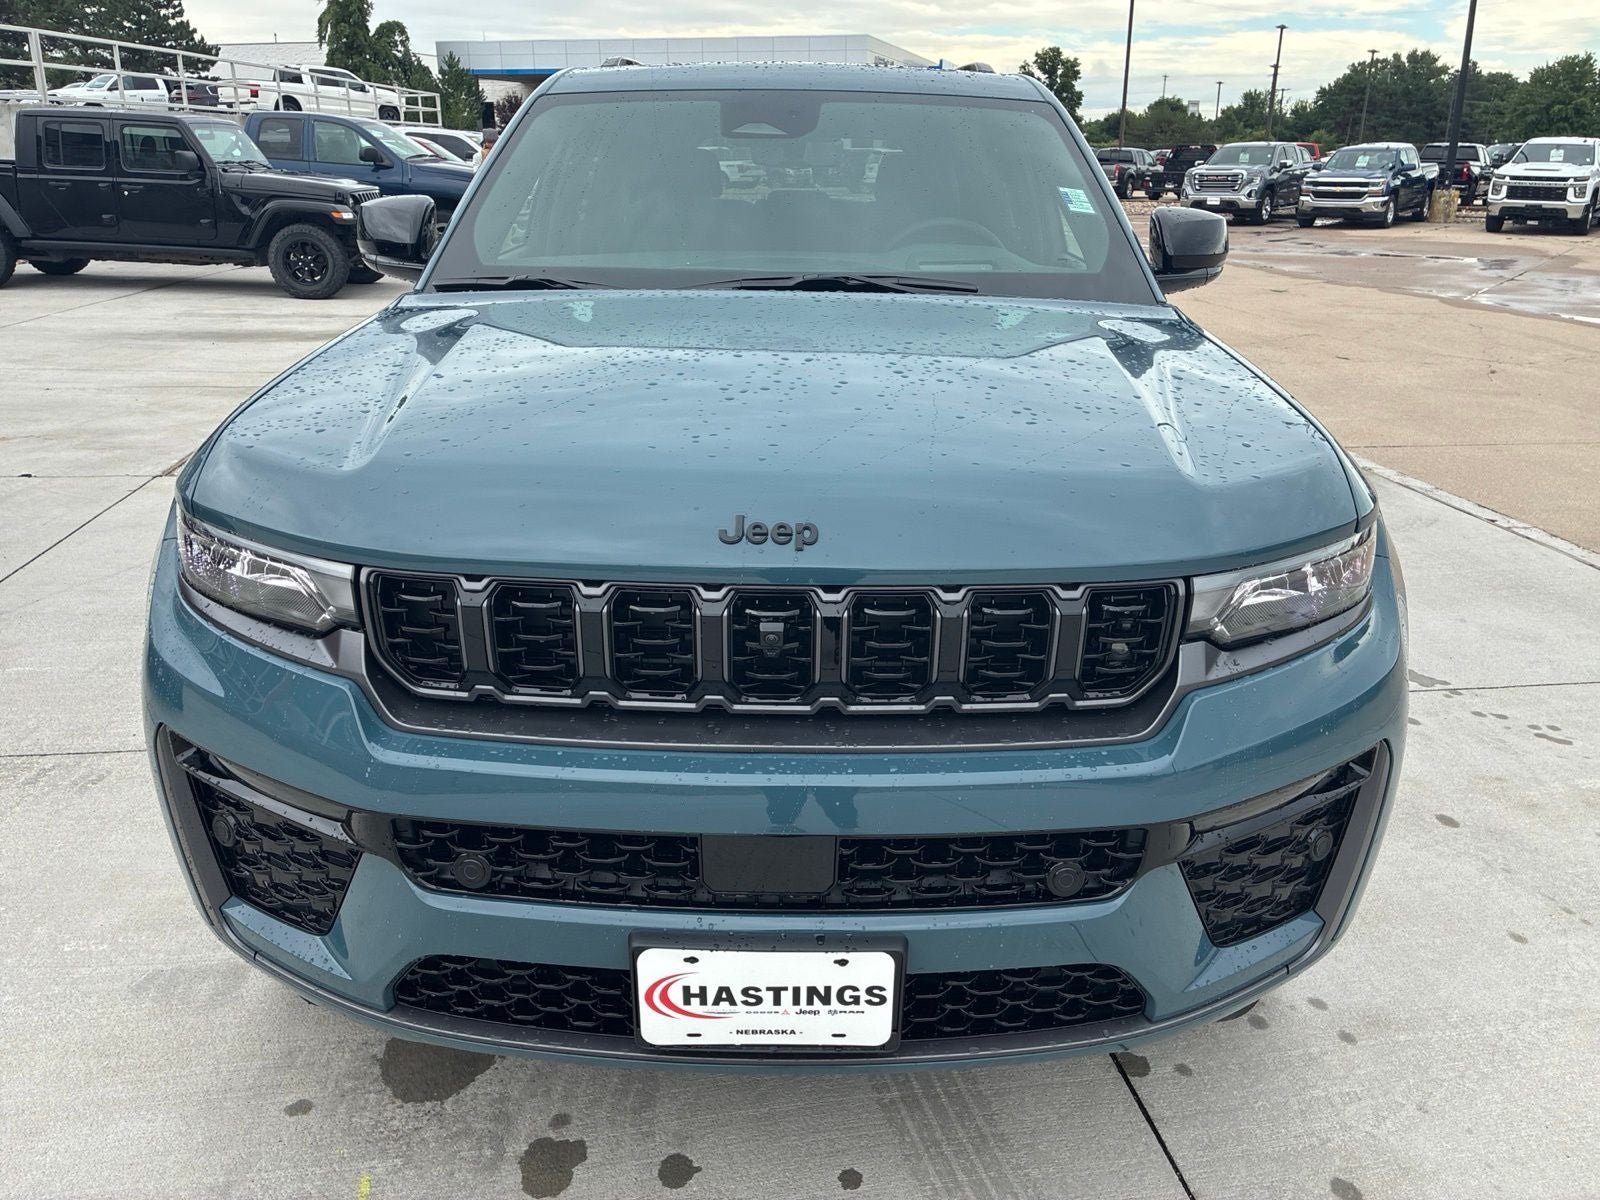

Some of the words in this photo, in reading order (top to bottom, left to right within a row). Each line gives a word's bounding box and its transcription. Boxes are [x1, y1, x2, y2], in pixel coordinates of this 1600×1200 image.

[718, 514, 819, 552] Jeep
[682, 985, 888, 1007] HASTINGS
[795, 1008, 821, 1016] Jeep
